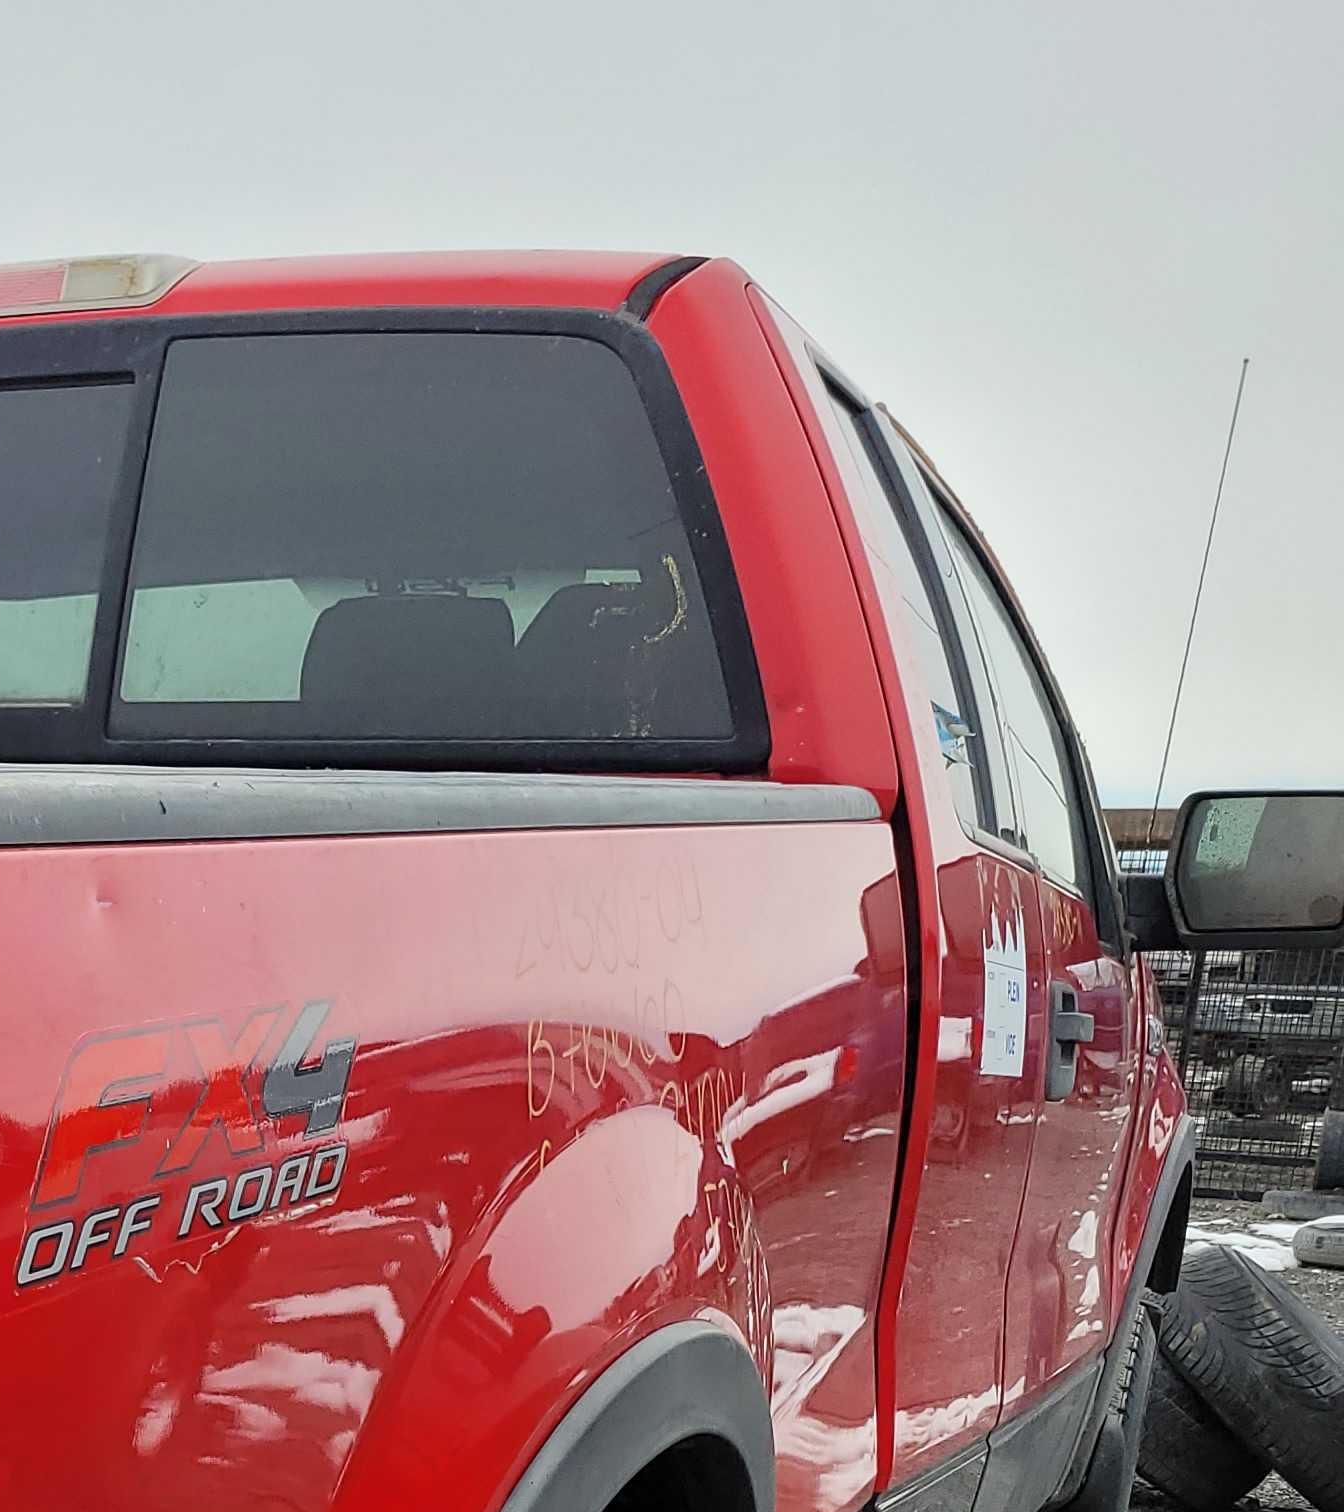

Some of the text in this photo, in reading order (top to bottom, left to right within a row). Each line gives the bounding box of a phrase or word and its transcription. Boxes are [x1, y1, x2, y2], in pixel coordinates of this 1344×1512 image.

[28, 997, 358, 1212] FX4
[14, 1141, 348, 1287] OFF ROAD
